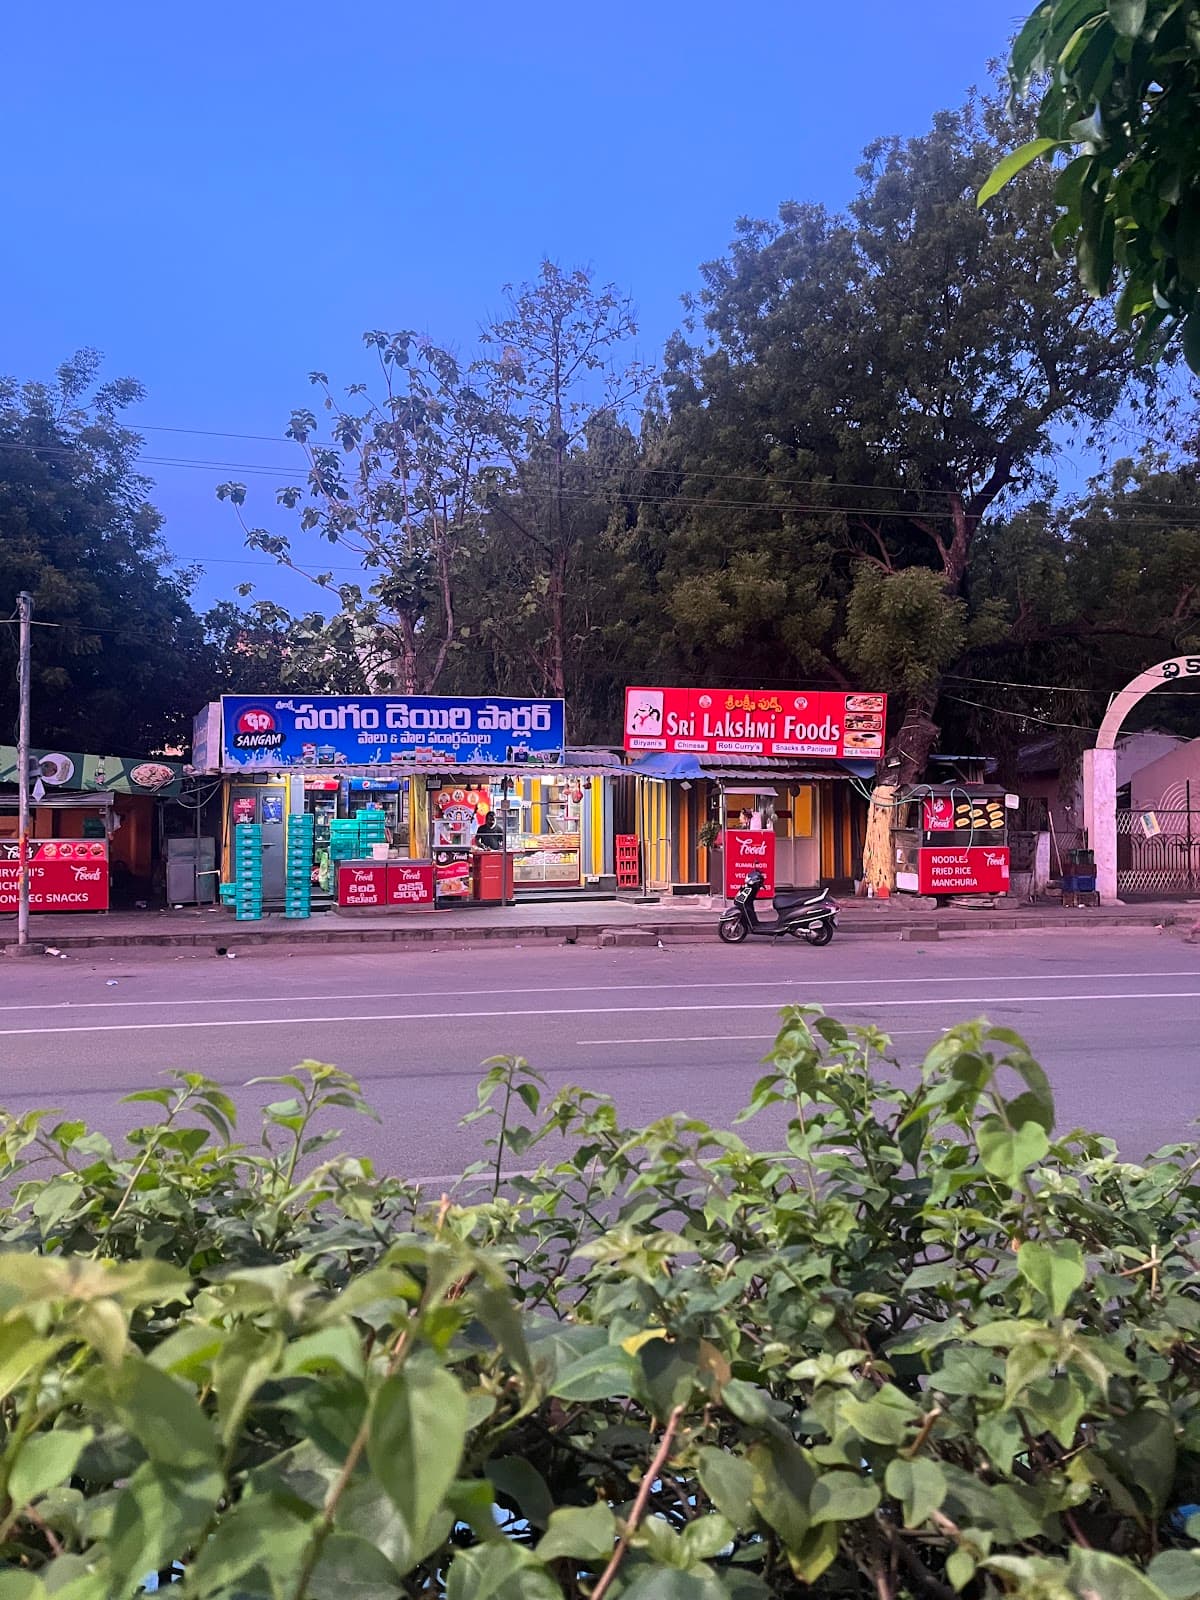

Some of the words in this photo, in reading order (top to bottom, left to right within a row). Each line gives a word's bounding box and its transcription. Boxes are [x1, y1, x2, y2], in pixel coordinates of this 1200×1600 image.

[295, 704, 379, 729] సంగం
[477, 704, 551, 738] పార్లర్
[236, 733, 282, 748] SANGAM
[357, 731, 388, 744] పాలు
[390, 733, 398, 744] &
[735, 836, 768, 855] Foods
[70, 865, 102, 881] Foods
[931, 867, 954, 875] FRIED
[955, 866, 972, 875] RICE
[931, 878, 978, 887] MANCHURIA
[46, 893, 89, 903] SNACKS
